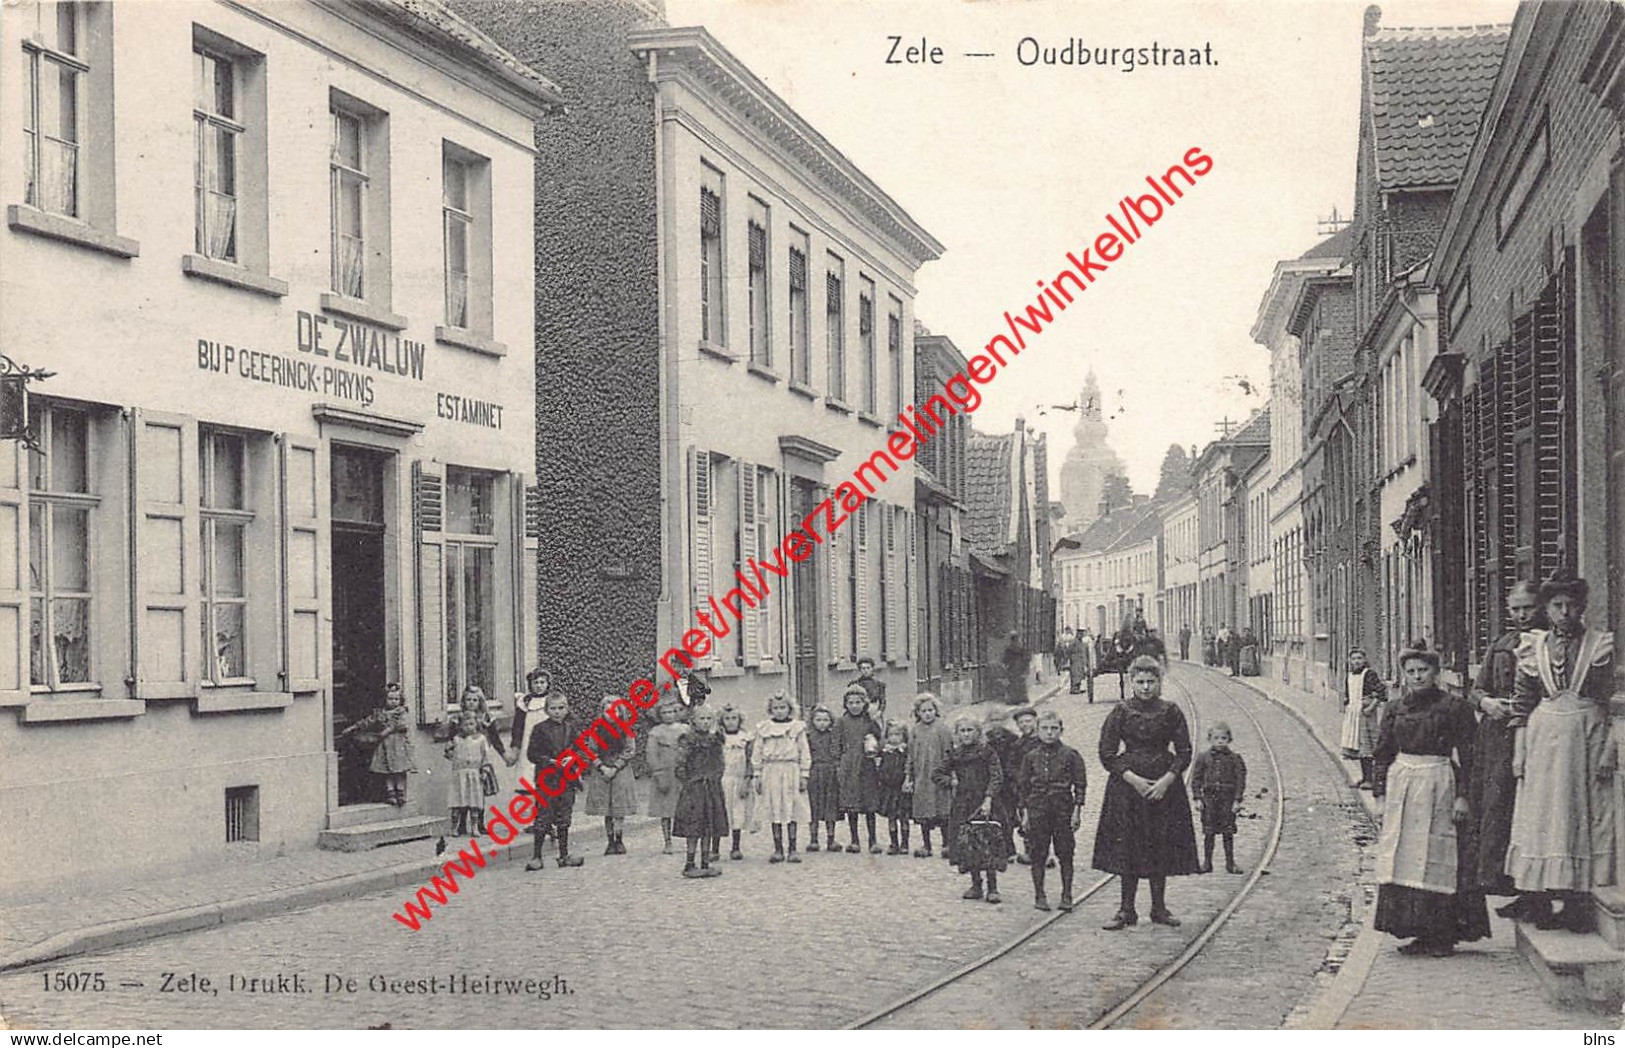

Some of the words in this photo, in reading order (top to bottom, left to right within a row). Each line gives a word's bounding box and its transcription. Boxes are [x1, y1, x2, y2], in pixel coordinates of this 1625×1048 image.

[198, 339, 220, 373] BIJ
[224, 345, 235, 374] P
[297, 311, 329, 357] DE
[334, 320, 425, 381] ZWALUW
[437, 392, 504, 430] ESTAMINET
